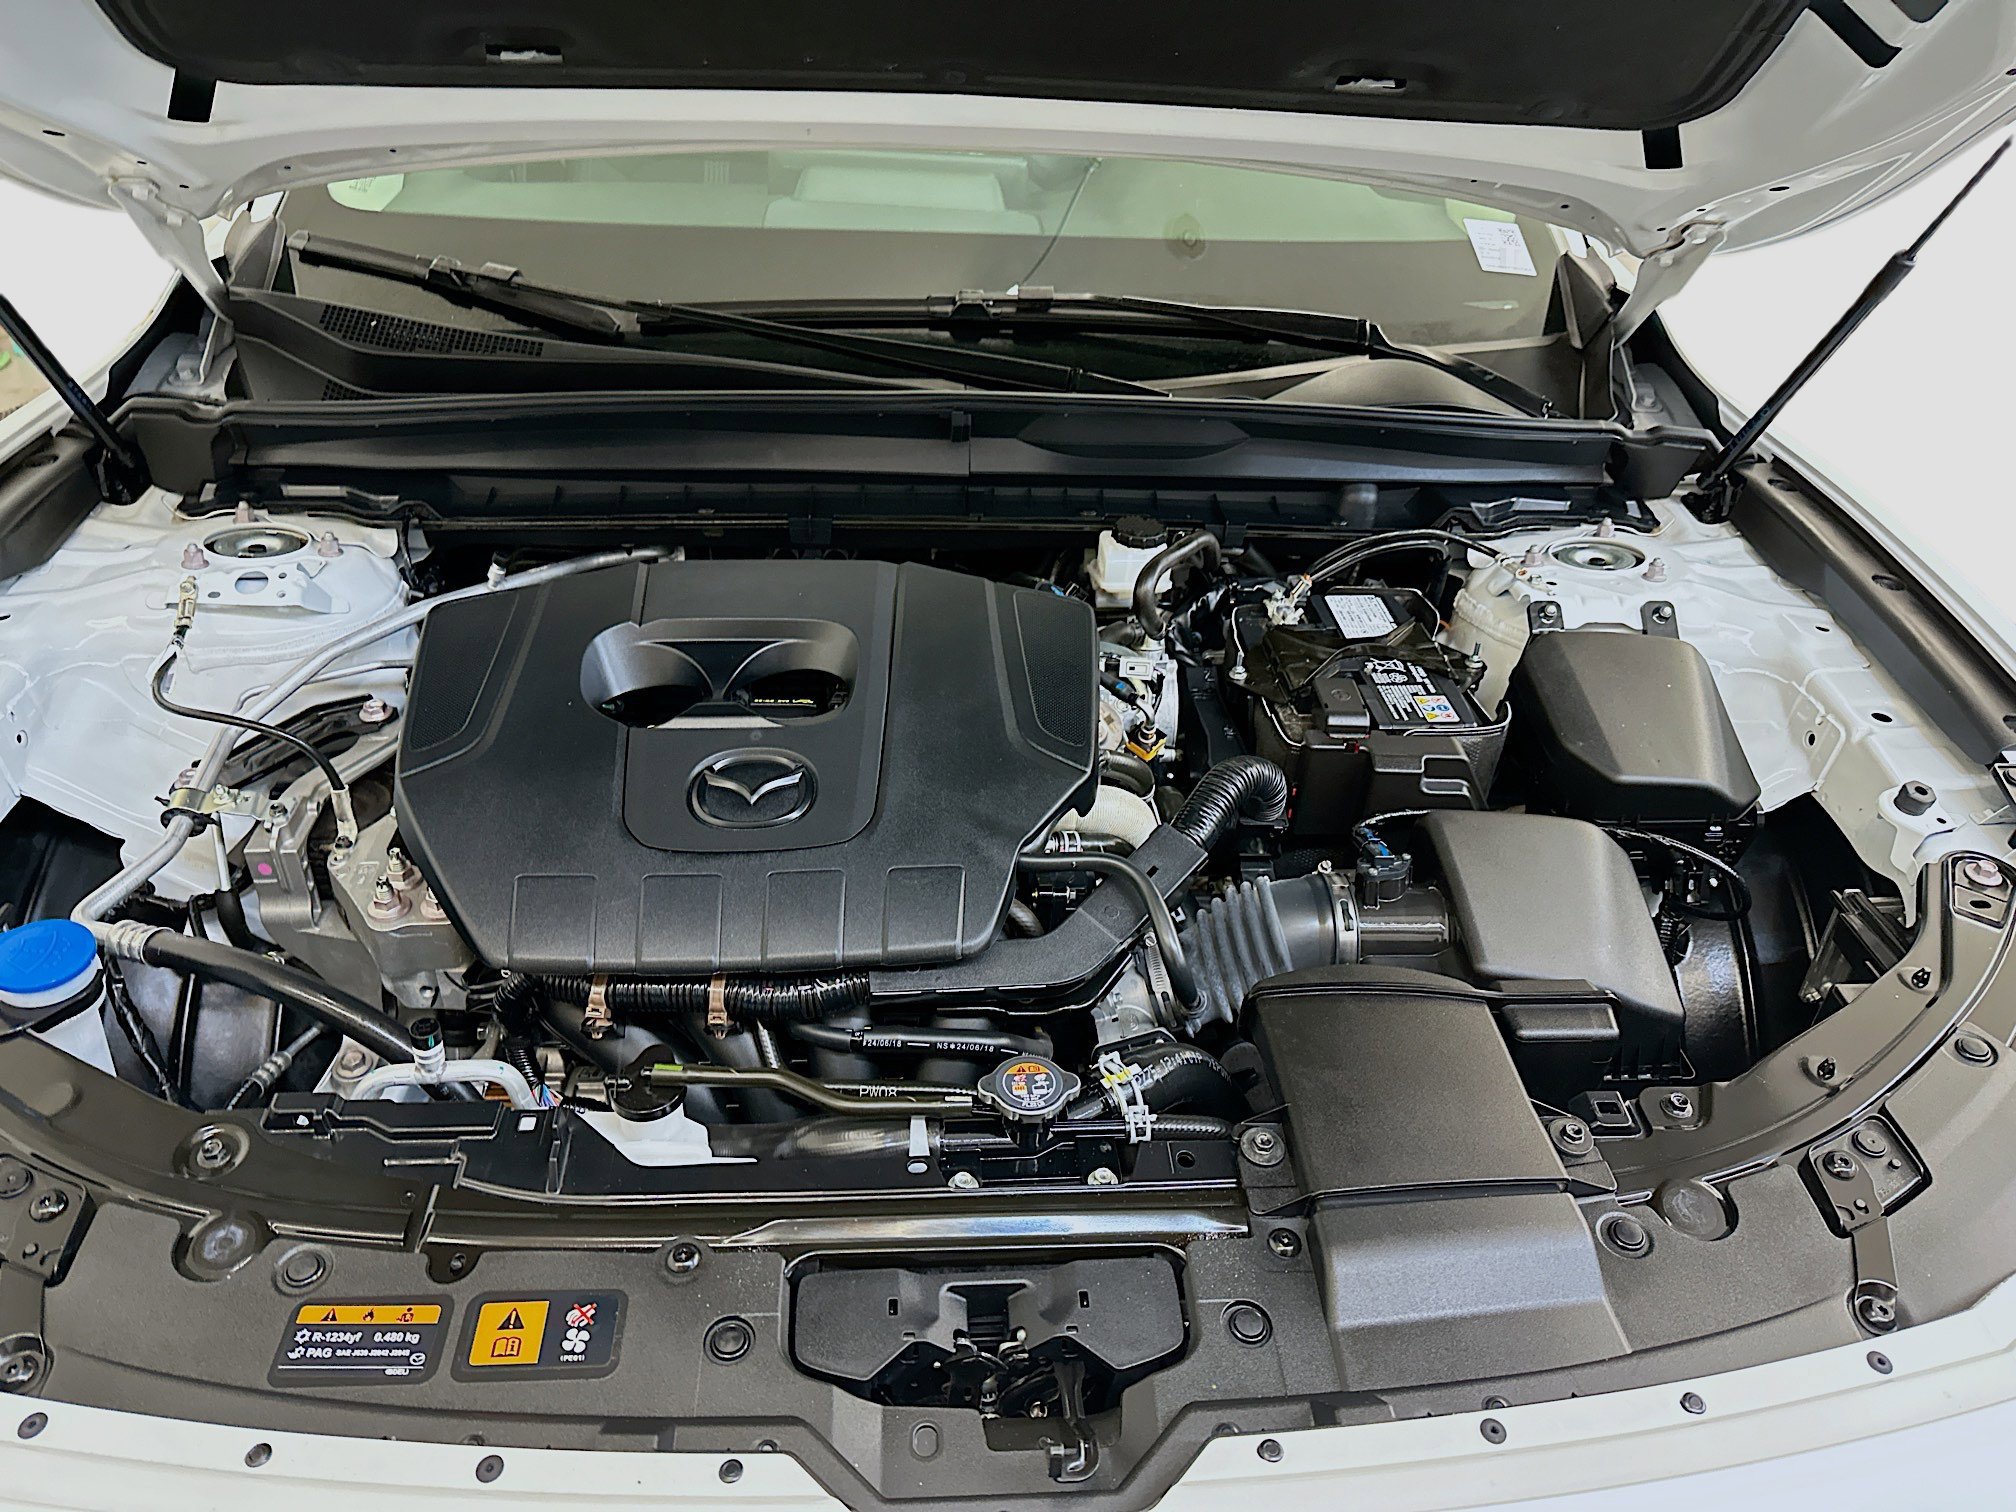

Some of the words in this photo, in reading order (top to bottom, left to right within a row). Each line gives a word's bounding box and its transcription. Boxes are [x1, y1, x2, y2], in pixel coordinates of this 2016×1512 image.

[311, 1331, 363, 1345] R-1234yf
[404, 1331, 421, 1345] kg
[306, 1347, 333, 1358] PAG
